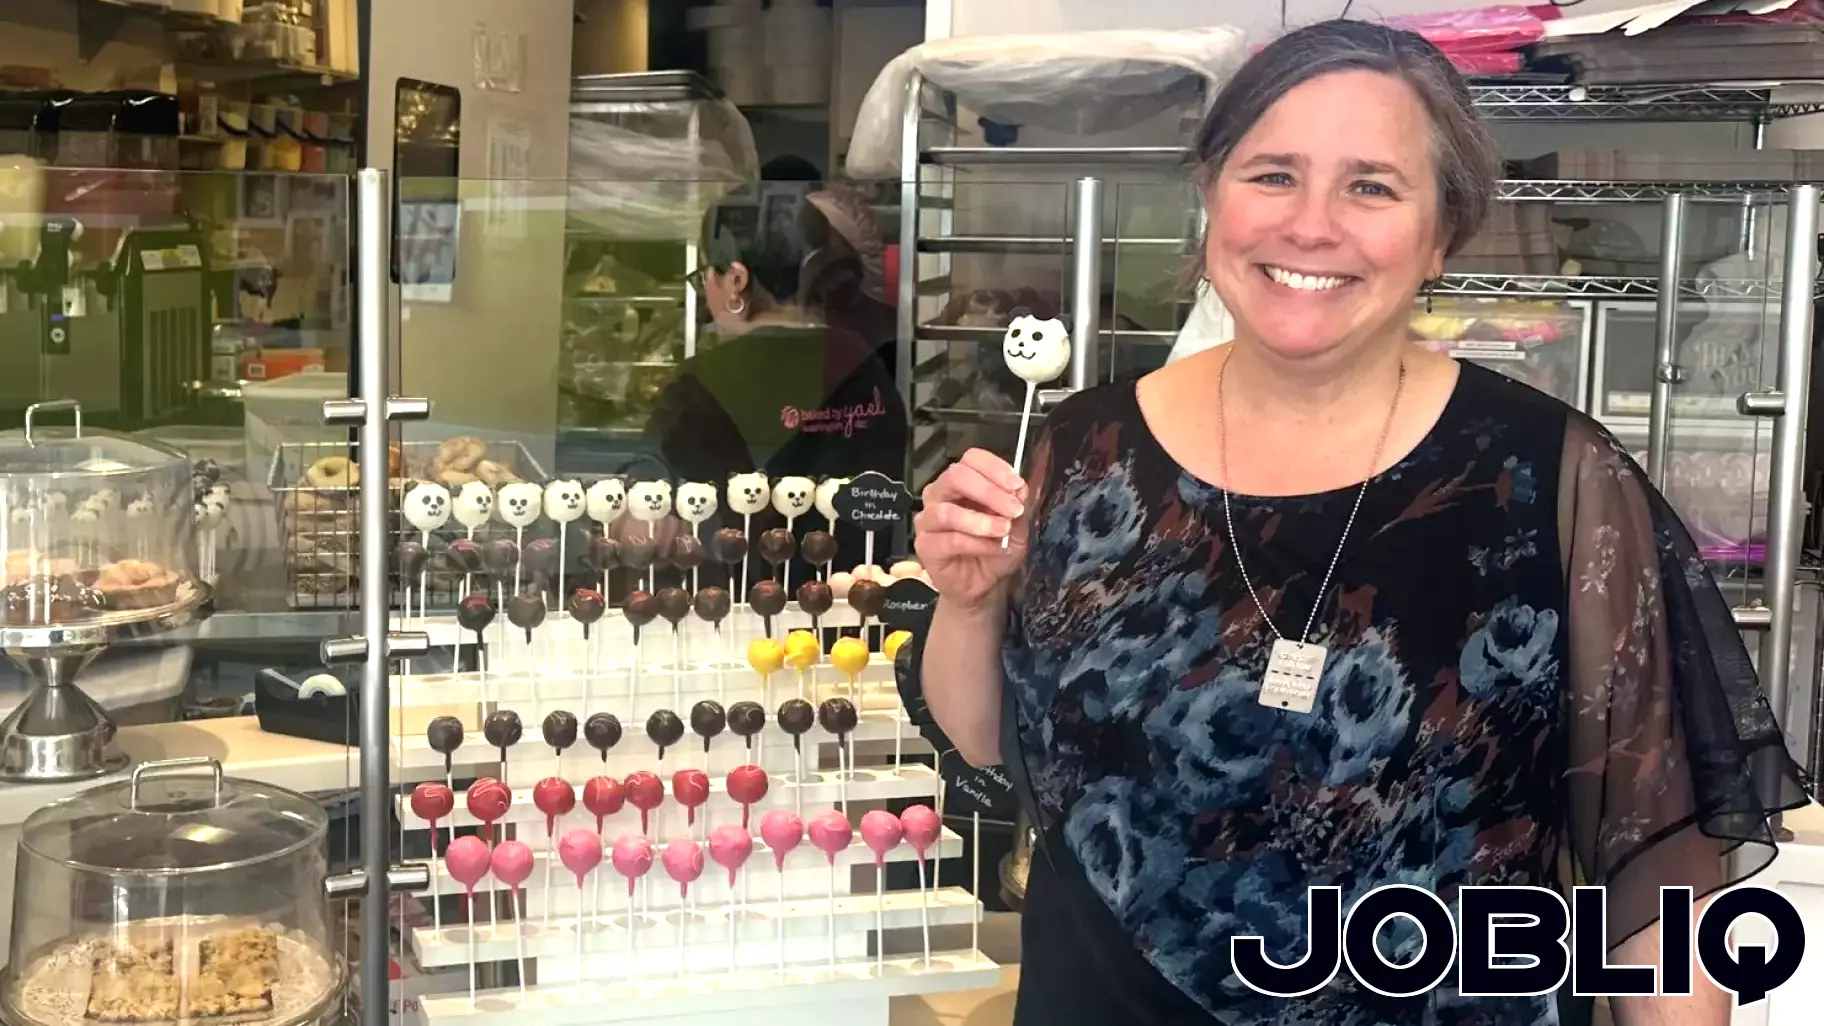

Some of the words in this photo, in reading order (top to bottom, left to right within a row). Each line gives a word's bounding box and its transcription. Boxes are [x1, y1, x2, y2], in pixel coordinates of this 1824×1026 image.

[843, 386, 886, 438] yael
[851, 486, 898, 502] Birthday
[864, 500, 876, 510] in
[851, 508, 901, 521] Chocolate
[974, 775, 986, 787] in
[955, 775, 993, 808] Vanilla
